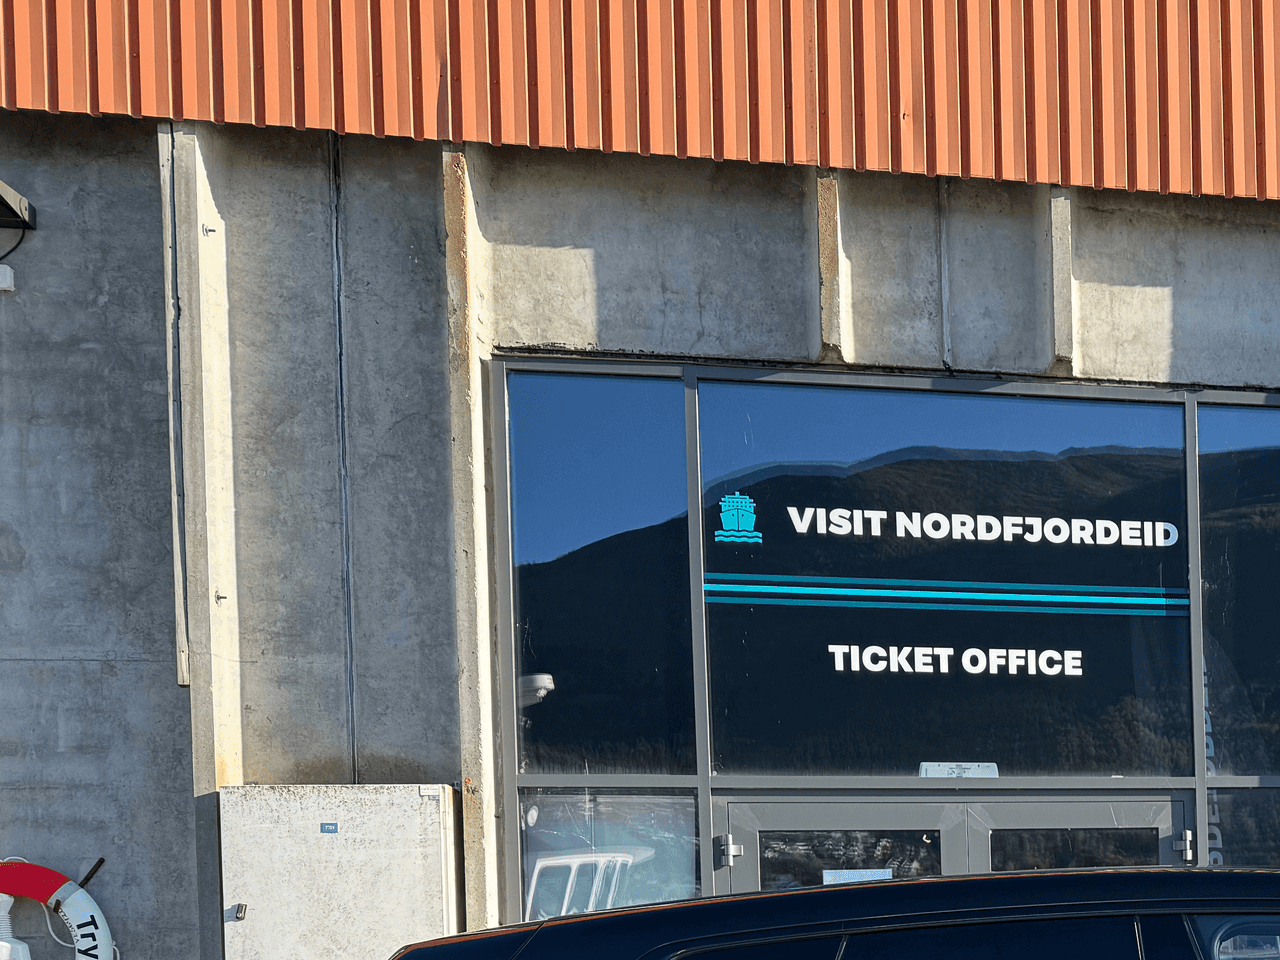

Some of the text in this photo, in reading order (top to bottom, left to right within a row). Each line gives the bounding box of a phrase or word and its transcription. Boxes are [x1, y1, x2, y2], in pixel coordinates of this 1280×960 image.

[786, 506, 1179, 547] VISIT NORDFJORDEID
[828, 644, 1083, 676] TICKET OFFICE
